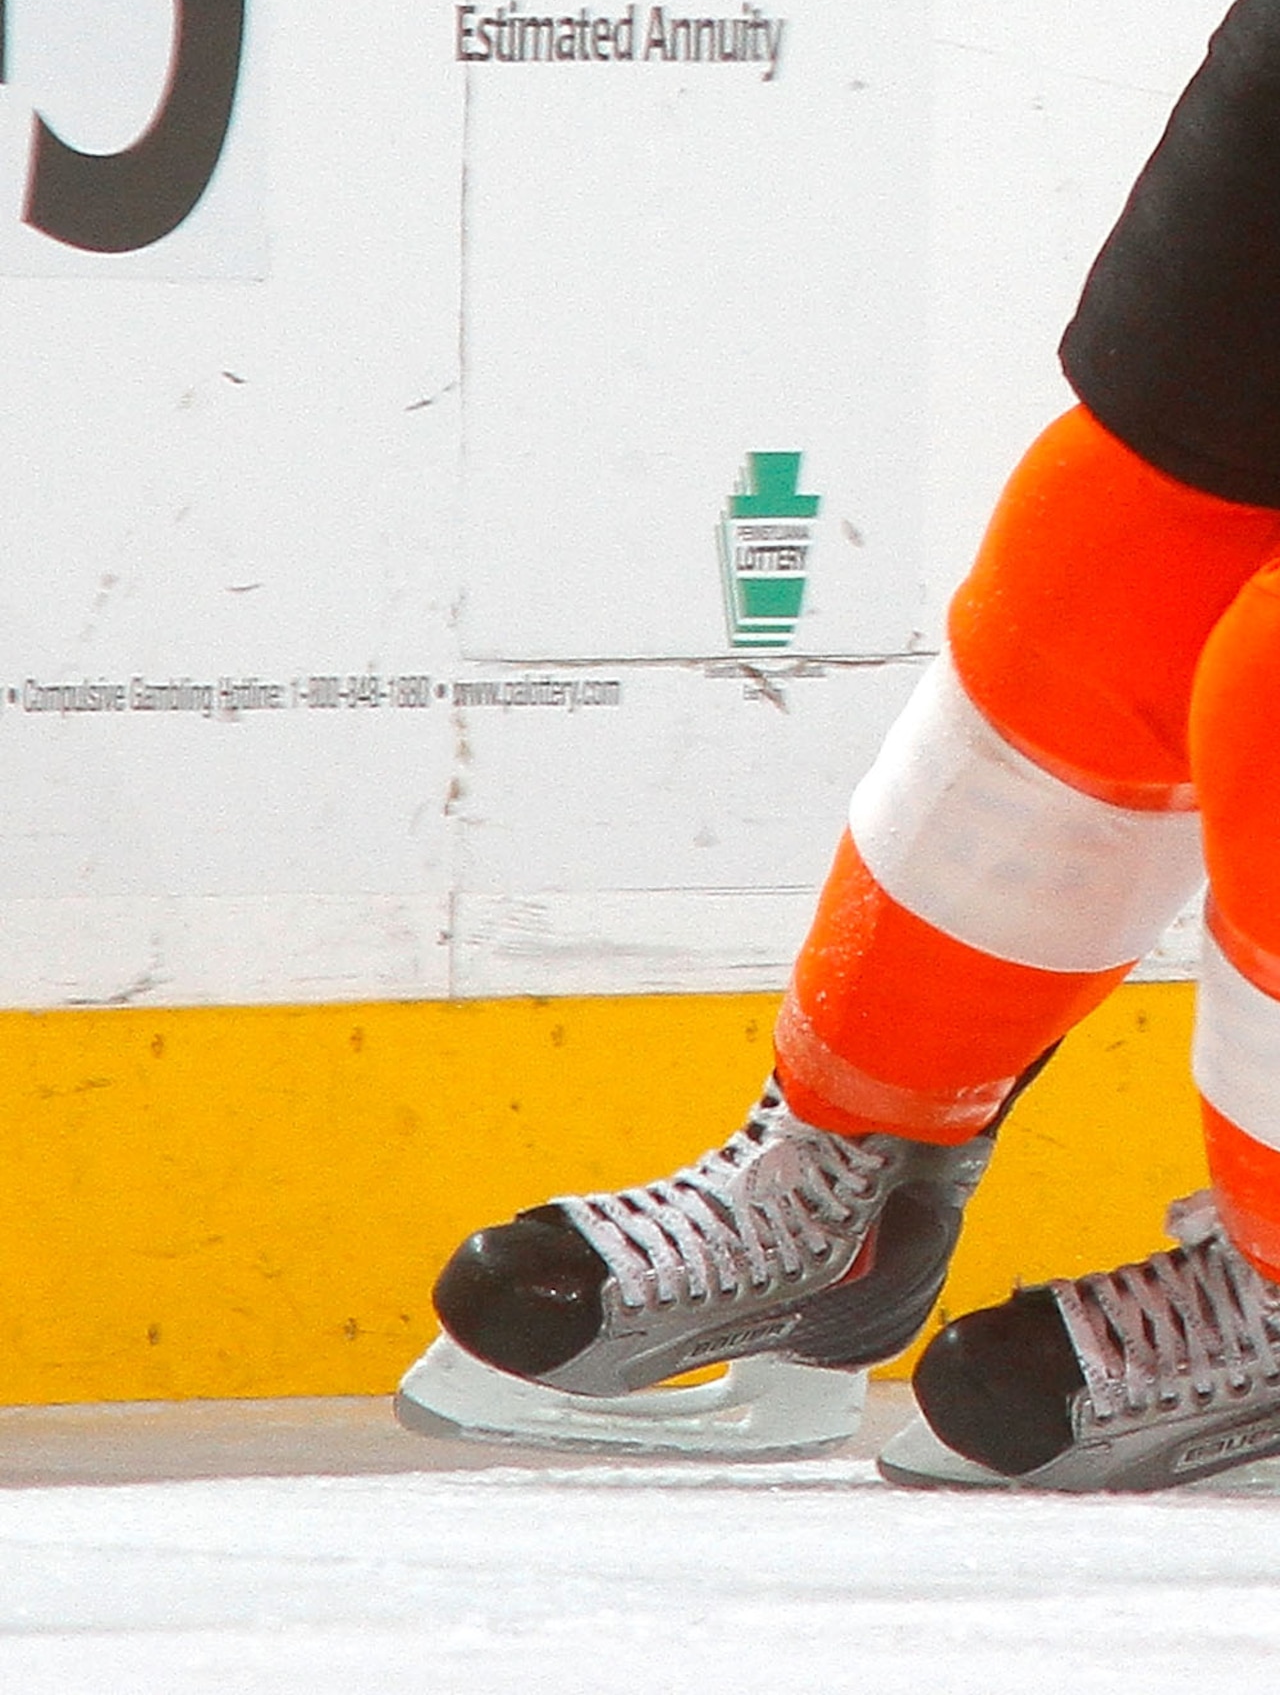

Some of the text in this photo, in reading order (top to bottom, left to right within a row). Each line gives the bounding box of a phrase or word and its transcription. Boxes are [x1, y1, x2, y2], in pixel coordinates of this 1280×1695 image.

[455, 0, 786, 83] Estimated Annuity
[736, 546, 809, 571] LOTTERY
[23, 678, 126, 718] Compulsive
[130, 678, 212, 718] Gambling
